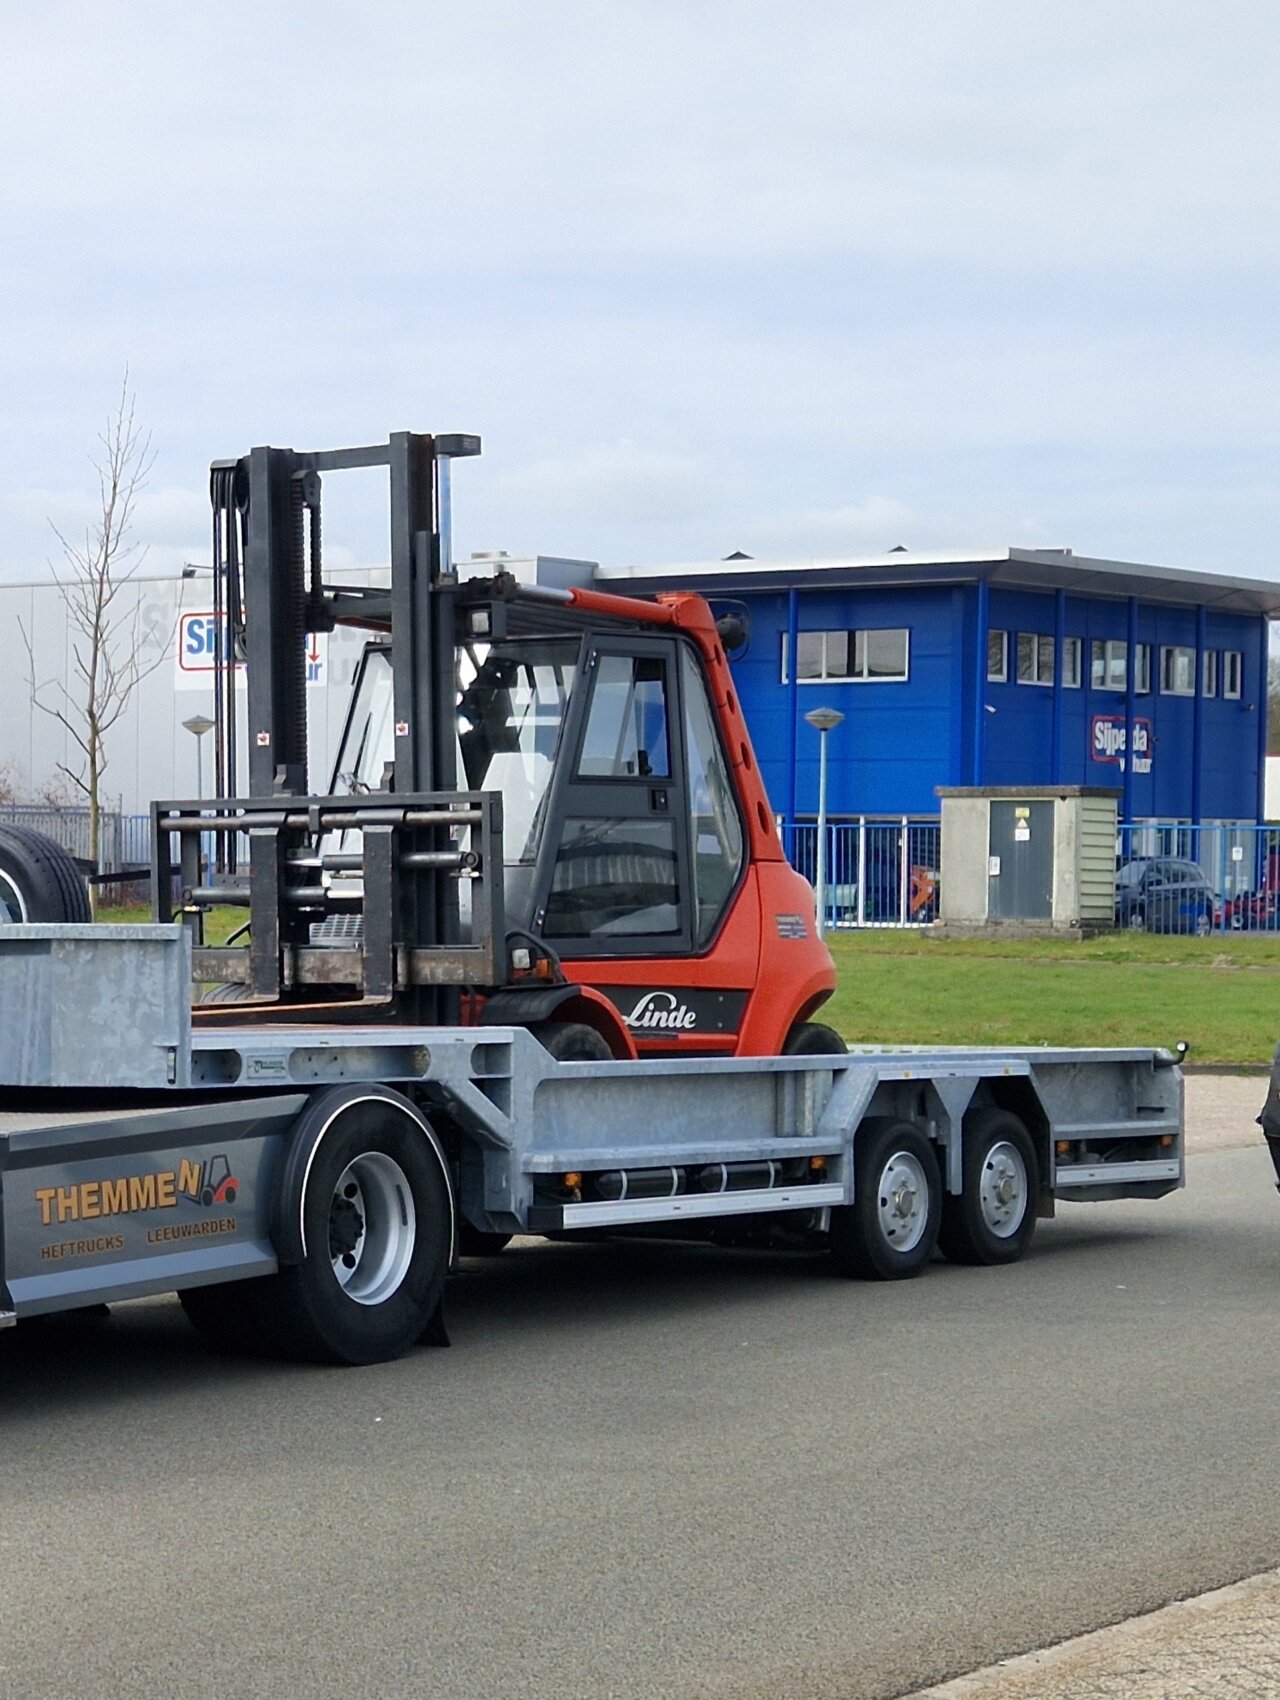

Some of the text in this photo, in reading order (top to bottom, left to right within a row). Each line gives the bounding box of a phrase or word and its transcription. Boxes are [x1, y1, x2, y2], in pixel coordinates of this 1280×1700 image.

[1094, 721, 1148, 756] Sijpeda
[621, 991, 697, 1029] Linde
[35, 1157, 201, 1226] THEMMEN
[41, 1217, 236, 1260] HEFTRUCKS LEEUWARDEN
